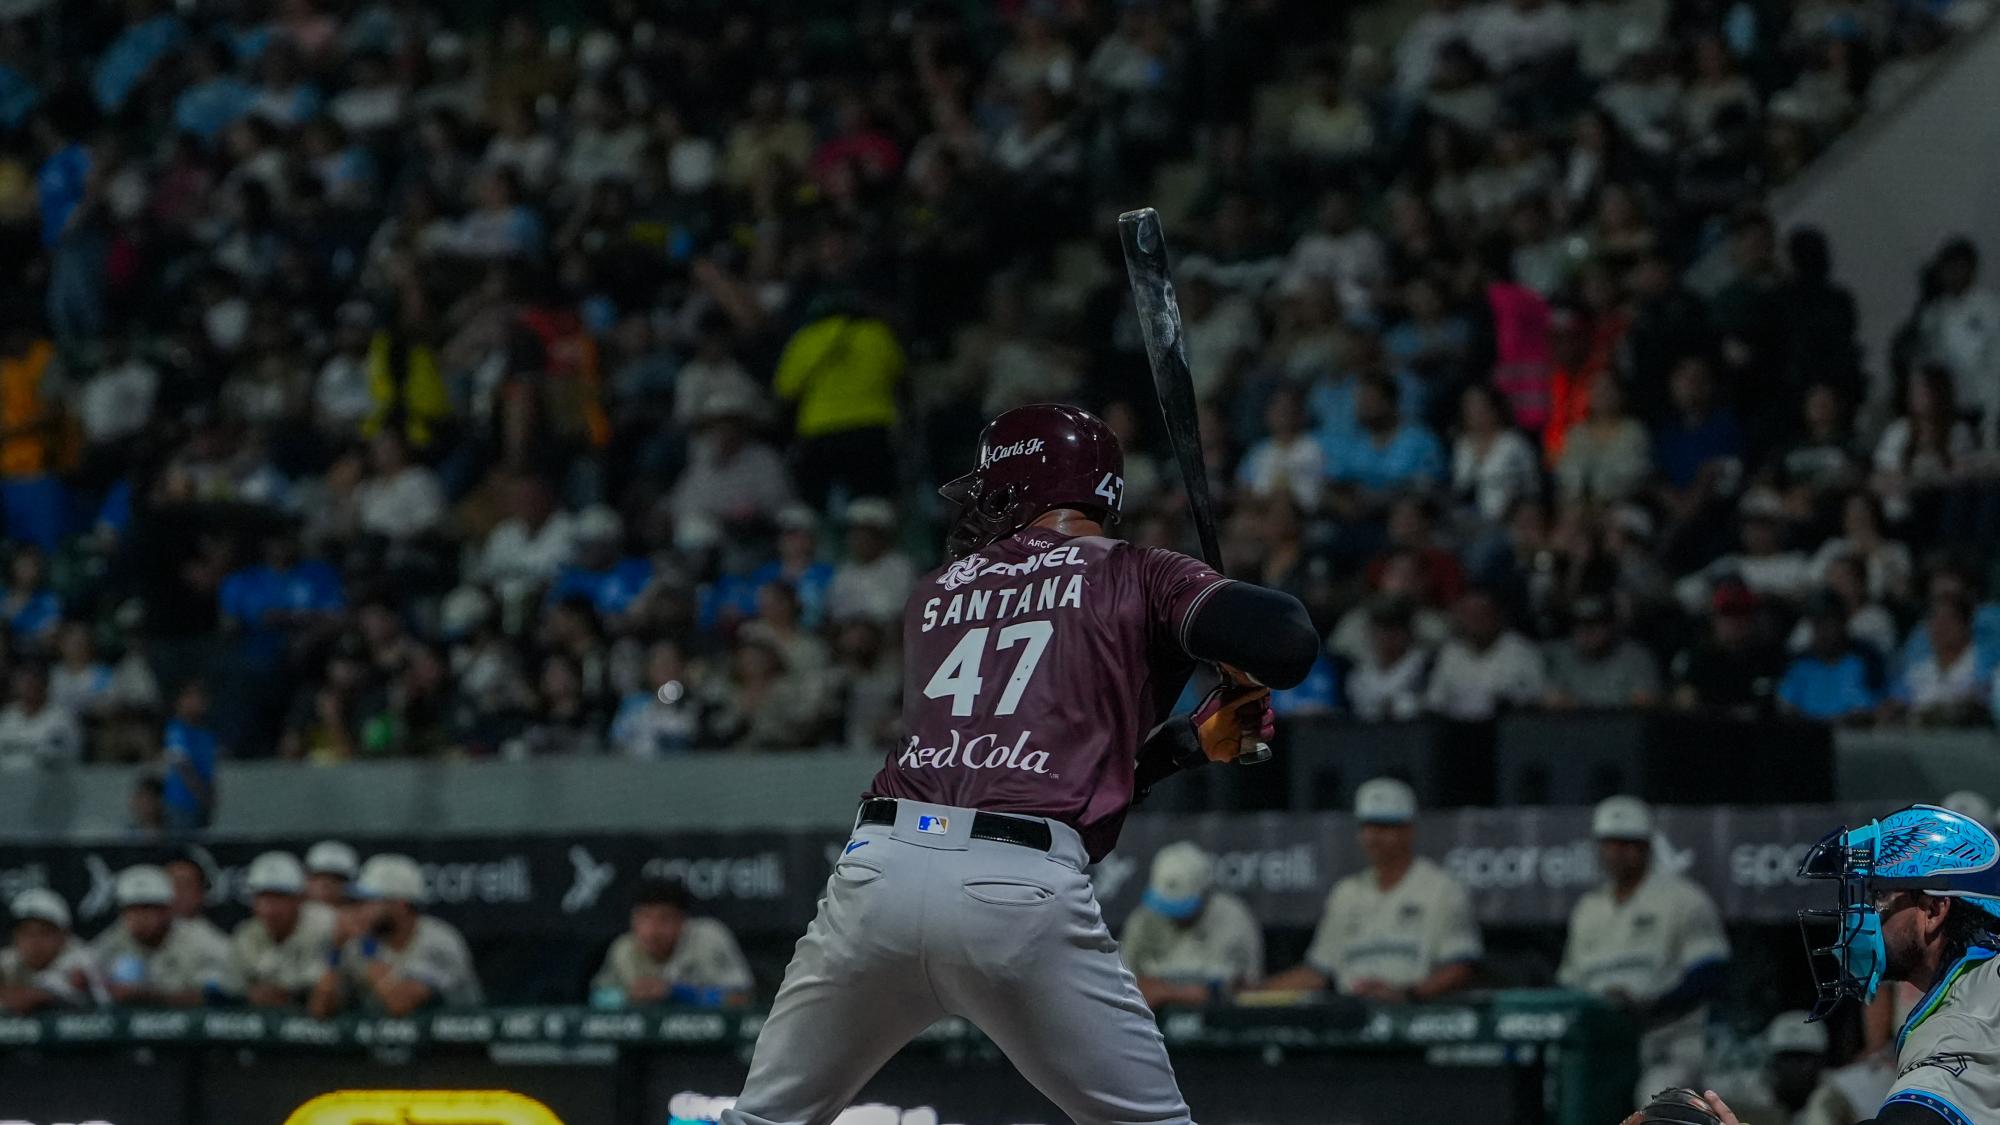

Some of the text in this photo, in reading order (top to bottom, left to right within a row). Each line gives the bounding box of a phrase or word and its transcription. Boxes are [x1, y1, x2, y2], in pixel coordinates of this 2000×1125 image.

[992, 437, 1046, 463] Carl's Jr.
[1095, 472, 1124, 512] 47
[978, 546, 1088, 577] ARIEL
[921, 573, 1084, 633] SANTANA
[922, 619, 1055, 717] 47
[898, 729, 1051, 775] Red Cola
